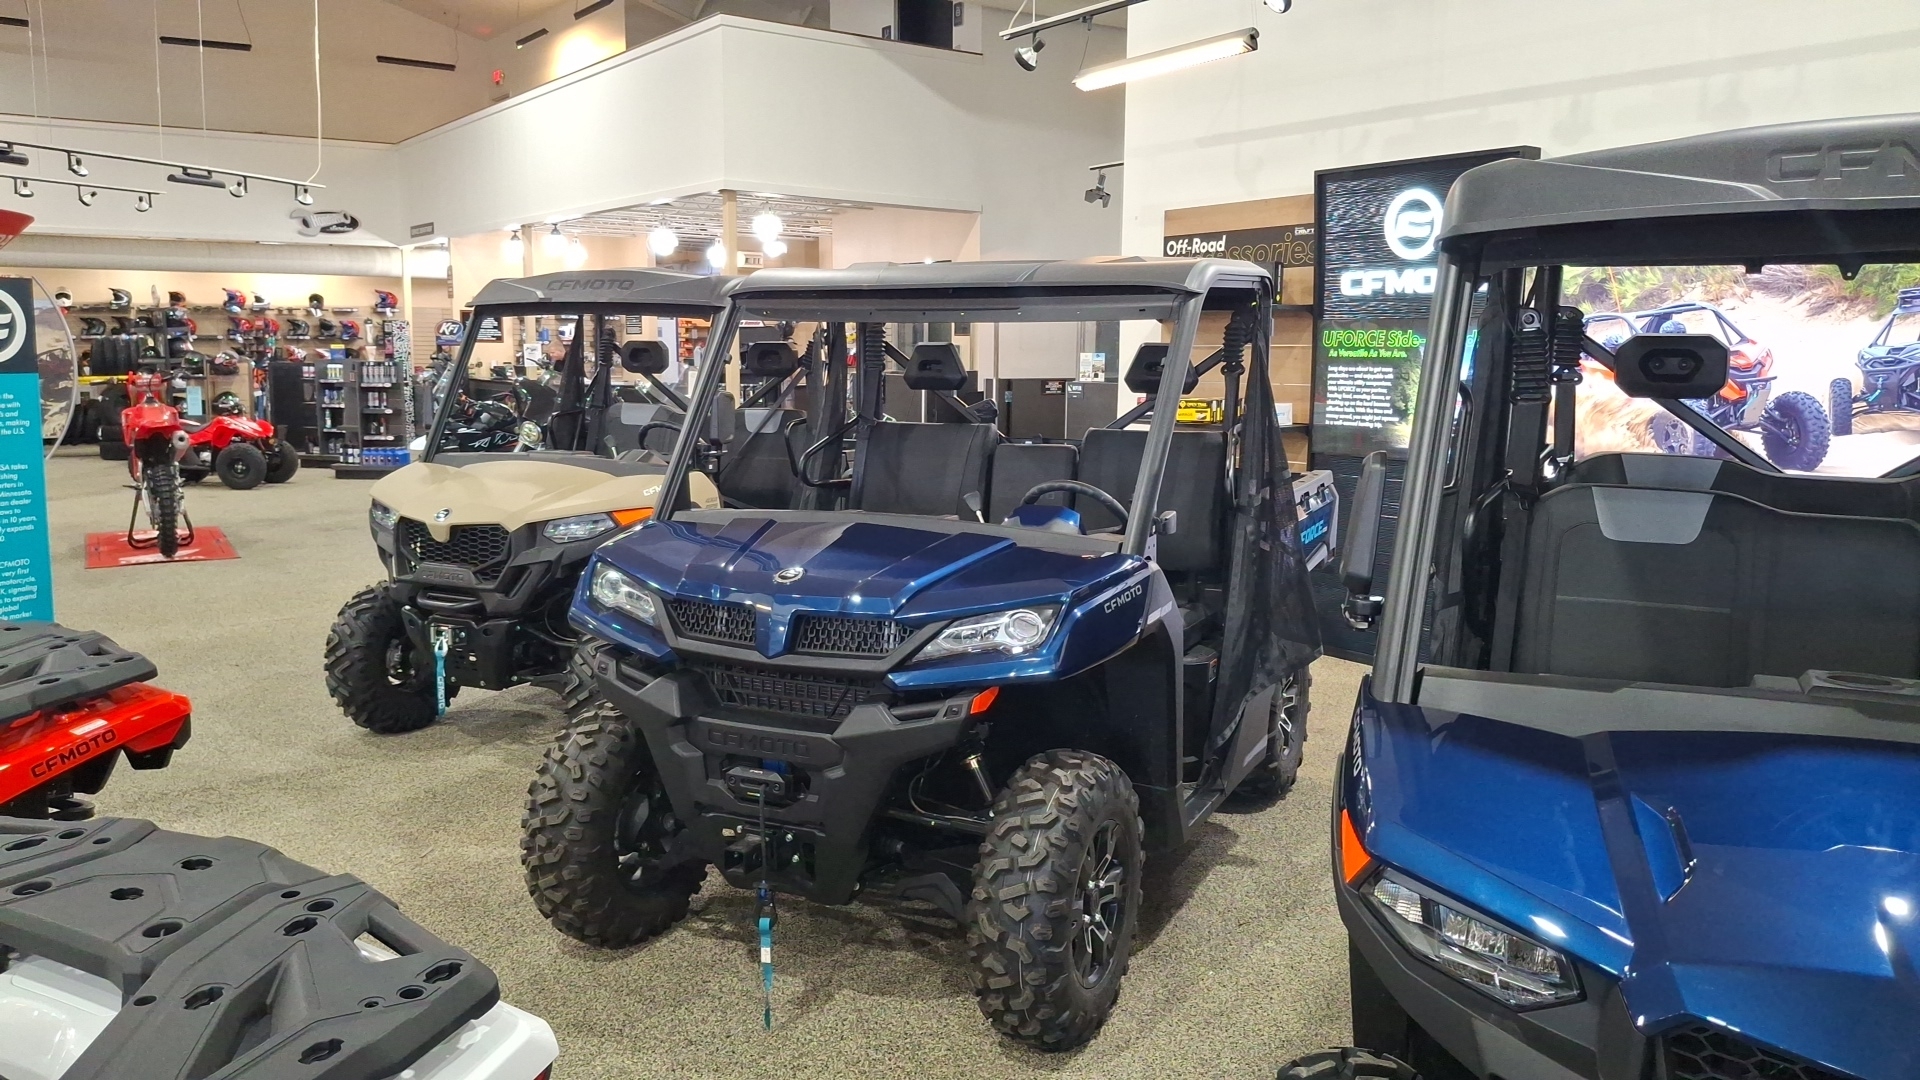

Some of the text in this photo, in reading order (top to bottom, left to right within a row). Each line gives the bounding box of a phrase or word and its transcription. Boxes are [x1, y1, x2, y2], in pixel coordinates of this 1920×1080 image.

[1167, 235, 1227, 256] Off-Road
[546, 279, 635, 291] CFMOTO
[1323, 330, 1387, 347] UFORCE
[1104, 585, 1142, 613] CFMOTO
[437, 676, 445, 709] CFMOTO
[31, 728, 117, 778] CFMOTO
[708, 727, 810, 759] CFMOTO
